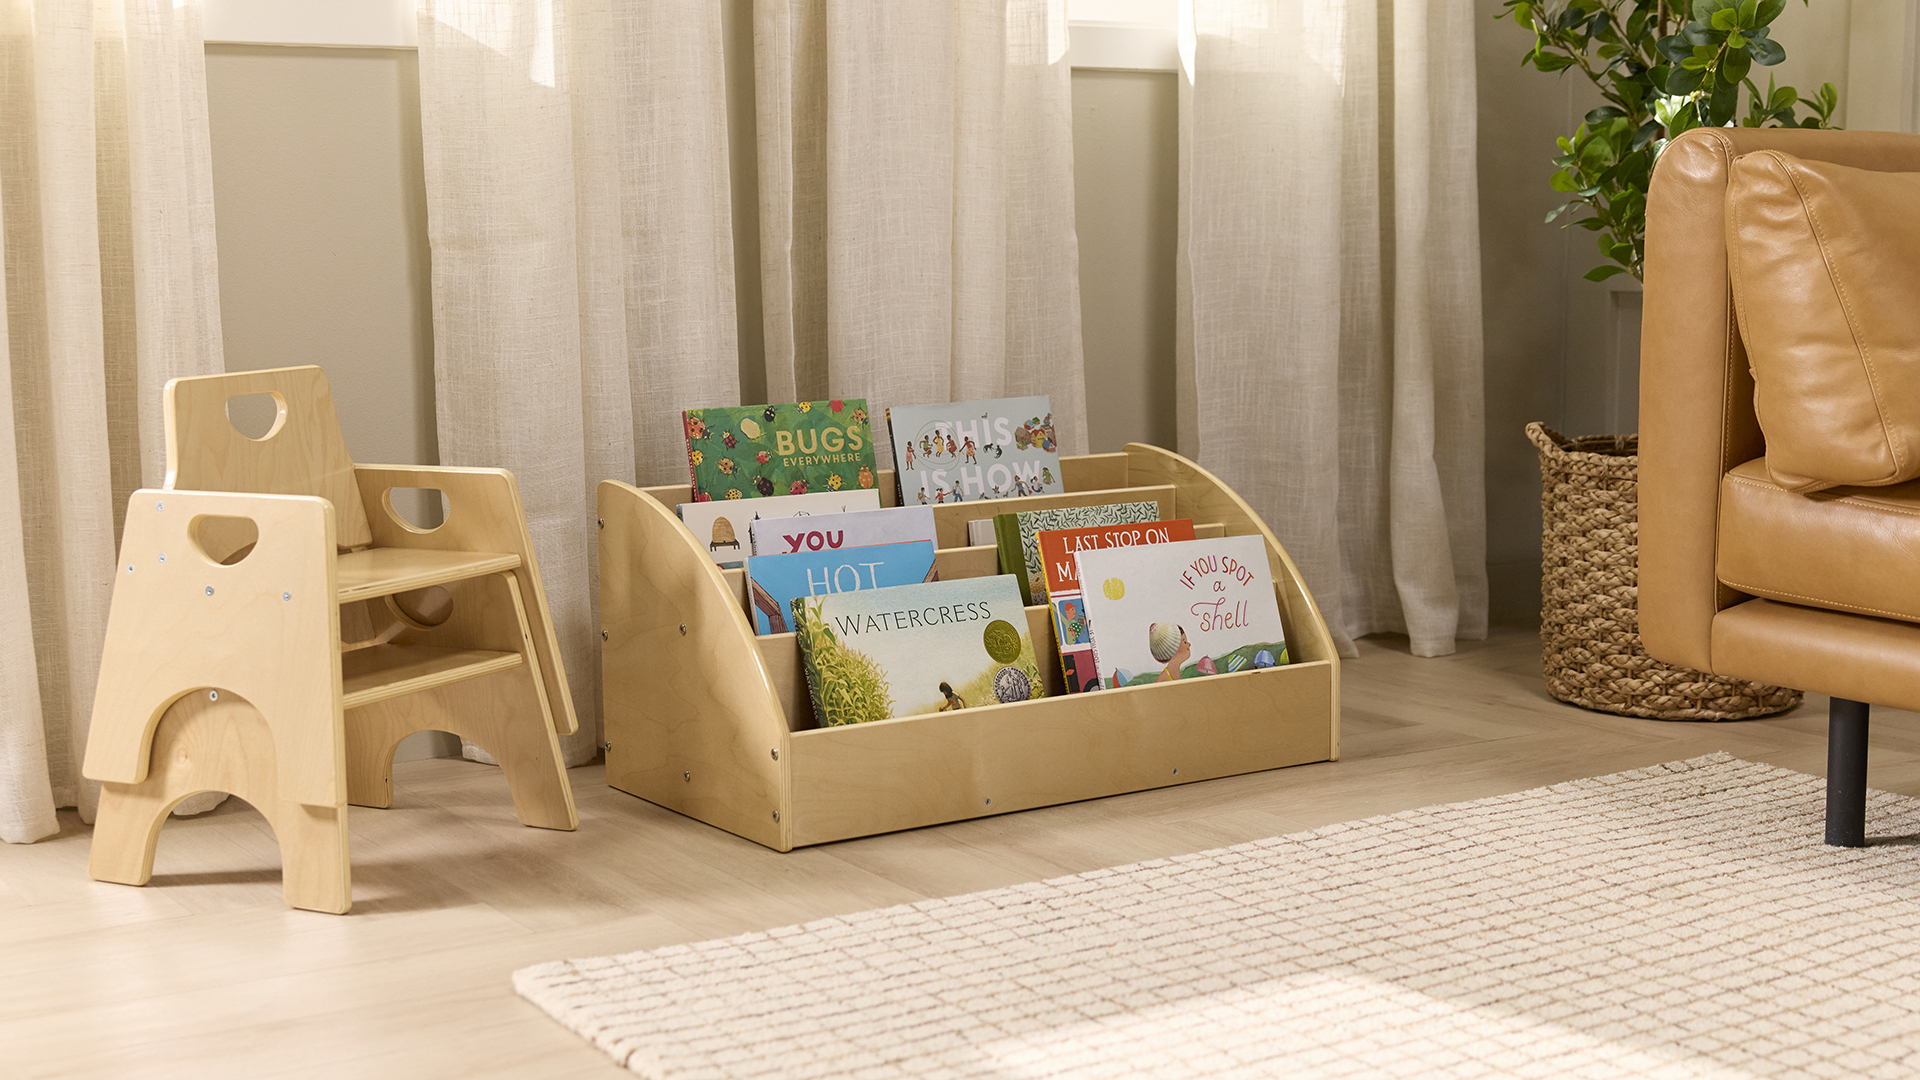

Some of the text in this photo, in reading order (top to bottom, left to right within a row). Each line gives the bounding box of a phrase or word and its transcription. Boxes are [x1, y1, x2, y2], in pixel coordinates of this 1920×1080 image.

[775, 425, 864, 456] BUGS
[934, 416, 1012, 450] THIS
[783, 452, 861, 467] EVERYWHERE
[920, 468, 951, 499] IS
[960, 460, 1041, 496] HOW
[1062, 527, 1170, 554] LAST STOP ON
[806, 561, 885, 596] HOT
[1056, 561, 1078, 582] M
[1180, 555, 1254, 590] IF YOU SPOT
[1213, 580, 1226, 592] a
[835, 601, 992, 637] WATERCRESS
[1190, 596, 1249, 632] shell
